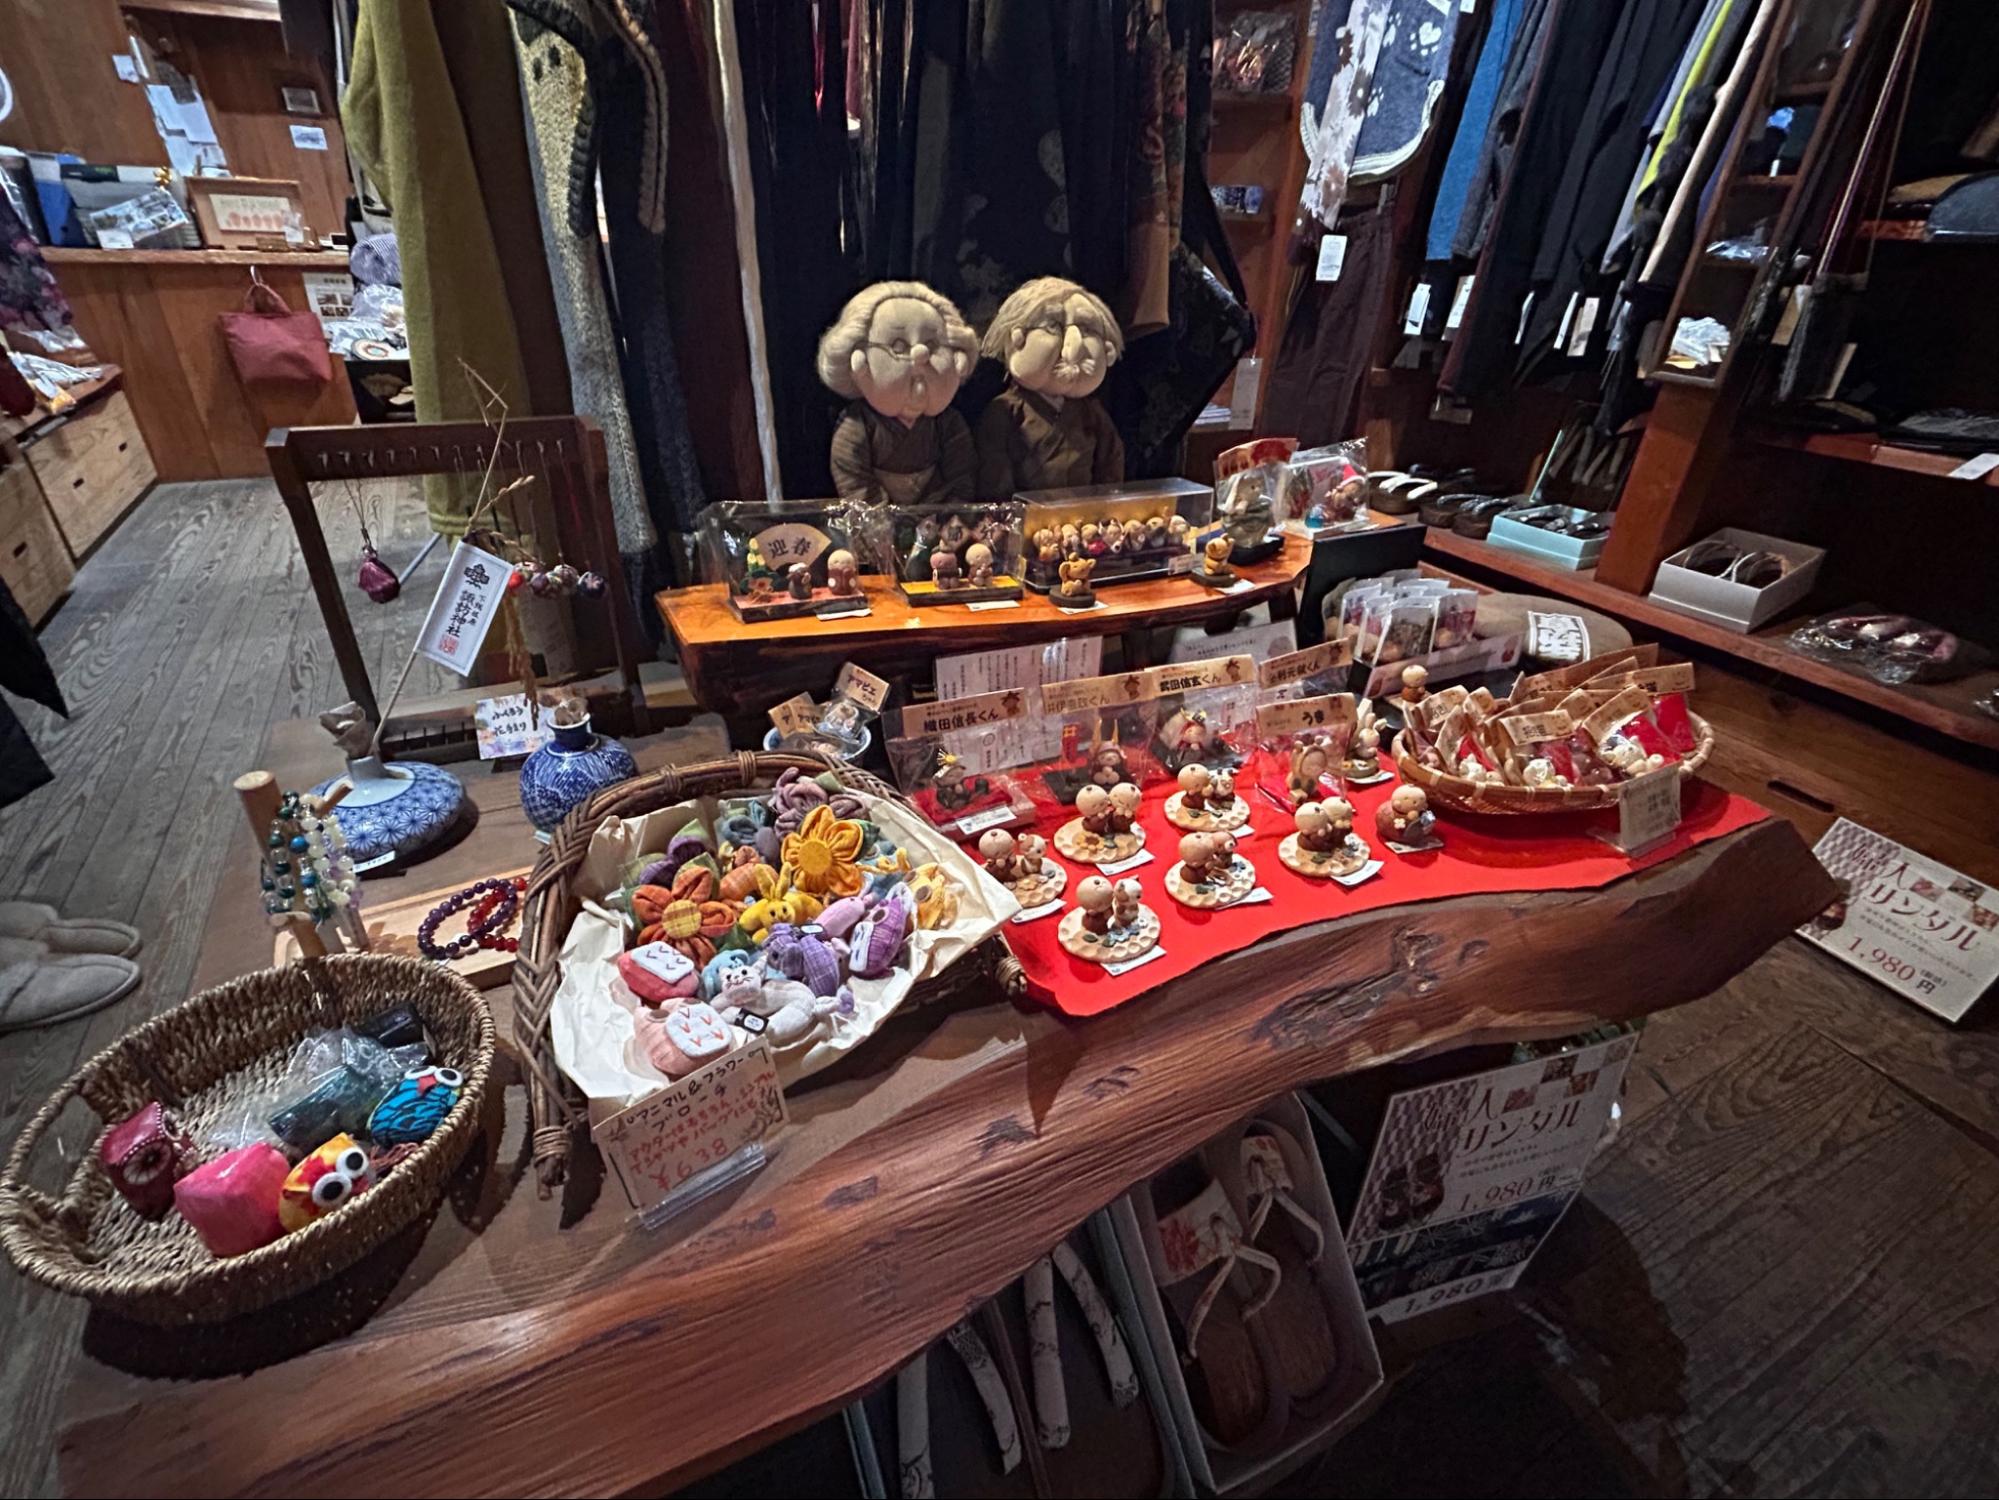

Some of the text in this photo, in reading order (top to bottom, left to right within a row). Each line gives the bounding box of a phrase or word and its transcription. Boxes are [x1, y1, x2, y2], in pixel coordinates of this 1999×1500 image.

[768, 538, 811, 559] 迎春
[446, 590, 476, 638] 諏訪神社
[1159, 675, 1222, 692] 武田信玄くん
[923, 708, 999, 733] 織田信長くん
[651, 1083, 727, 1133] ブローチ
